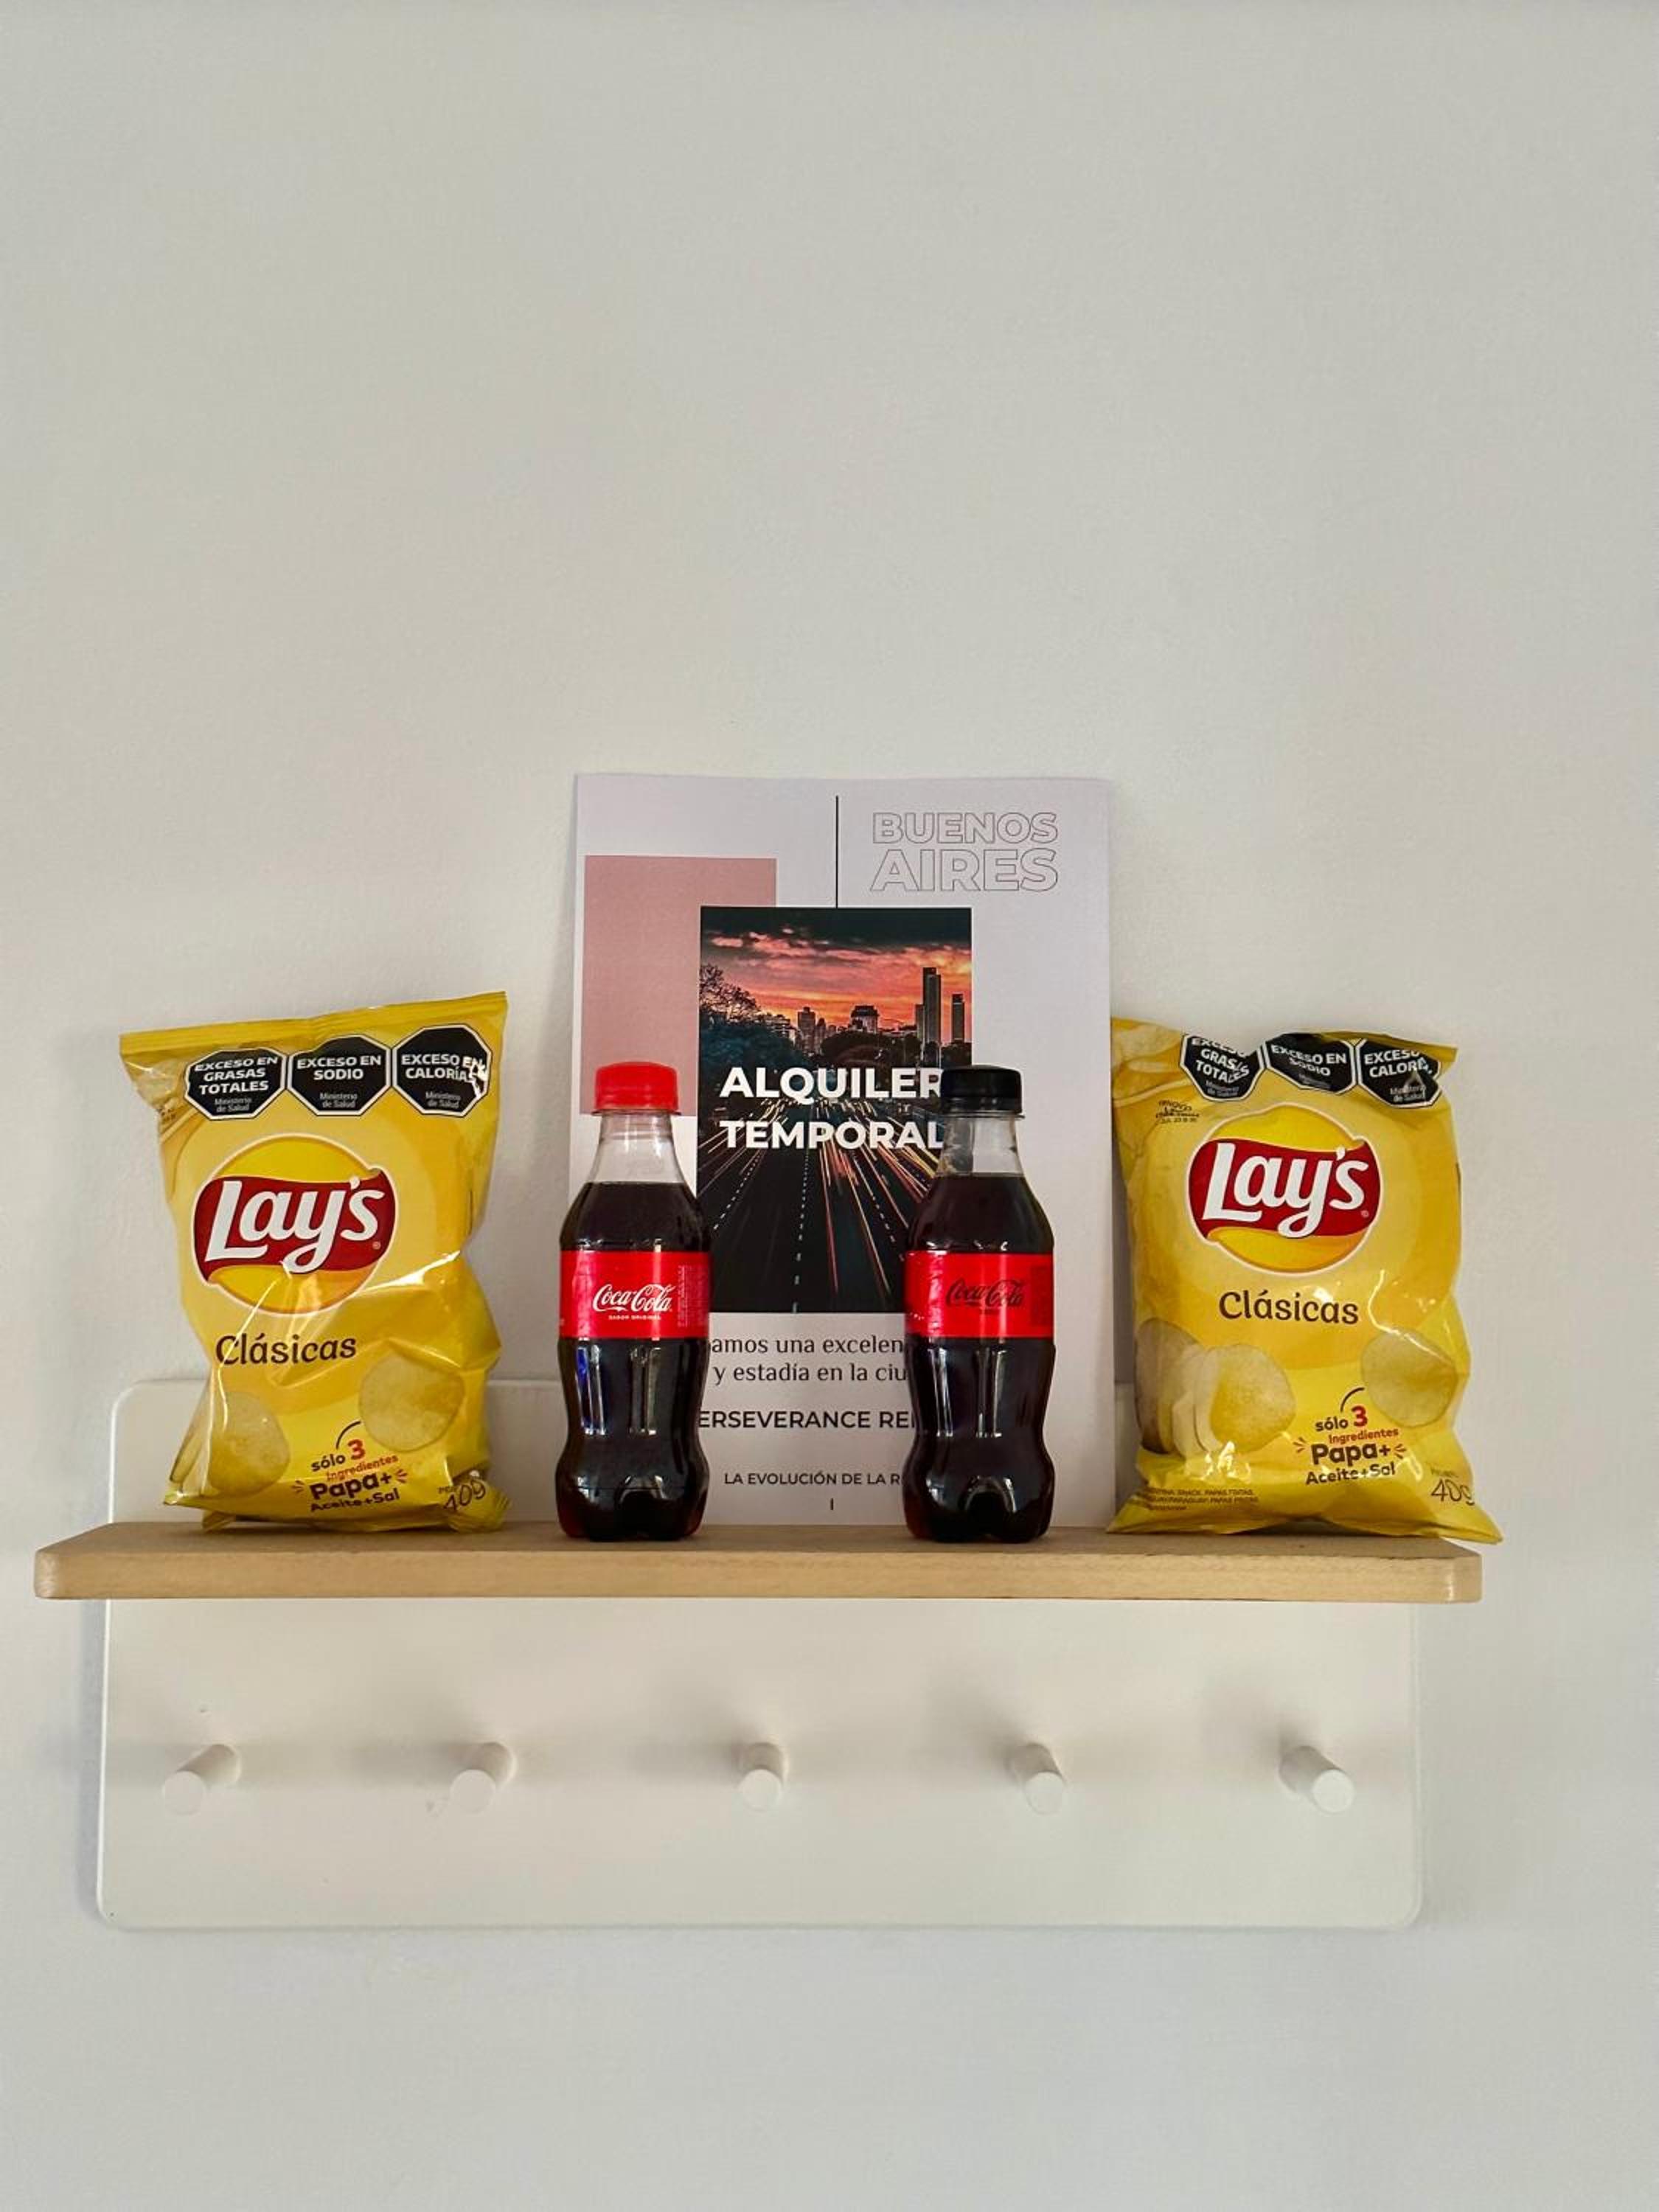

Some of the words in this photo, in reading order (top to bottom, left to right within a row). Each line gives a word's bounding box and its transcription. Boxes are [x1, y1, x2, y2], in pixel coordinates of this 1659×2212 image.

[872, 812, 1059, 844] BUENOS
[869, 847, 1059, 891] AIRES
[195, 1058, 254, 1071] EXCESO
[257, 1057, 278, 1065] EN
[297, 1056, 358, 1069] EXCESO
[359, 1055, 382, 1065] EN
[400, 1054, 460, 1065] EXCESO
[1325, 1053, 1347, 1064] EN
[203, 1068, 266, 1082] GRASAS
[313, 1068, 364, 1080] SODIO
[719, 1067, 943, 1105] ALQUILER
[199, 1080, 269, 1095] TOTALES
[719, 1121, 944, 1150] TEMPORAL
[1202, 1142, 1369, 1239] Lay's
[204, 1175, 386, 1273] Lay's
[592, 1284, 676, 1312] Coca-Cola
[1218, 1289, 1359, 1325] Clásicas
[216, 1332, 357, 1365] Clásicas
[712, 1338, 768, 1353] amos
[776, 1338, 815, 1353] una
[822, 1335, 903, 1353] excelen
[713, 1366, 726, 1385] y
[733, 1363, 810, 1381] estadía
[817, 1367, 843, 1381] en
[851, 1363, 868, 1381] la
[875, 1363, 907, 1381] ciu
[698, 1411, 871, 1428] ERSEVERANCE
[1315, 1416, 1349, 1432] sólo
[1351, 1405, 1368, 1427] 3
[311, 1453, 346, 1472] sólo
[347, 1439, 366, 1461] 3
[1311, 1441, 1391, 1467] Papa+
[309, 1472, 392, 1500] Papa+
[724, 1473, 743, 1484] LA
[748, 1470, 837, 1485] EVOLUCIÓN
[842, 1473, 862, 1484] DE
[867, 1473, 886, 1484] LA
[1306, 1461, 1396, 1485] Aceite+Sal
[310, 1488, 400, 1512] Aceite+Sal
[443, 1479, 487, 1511] 40g
[1430, 1478, 1475, 1506] 40g
